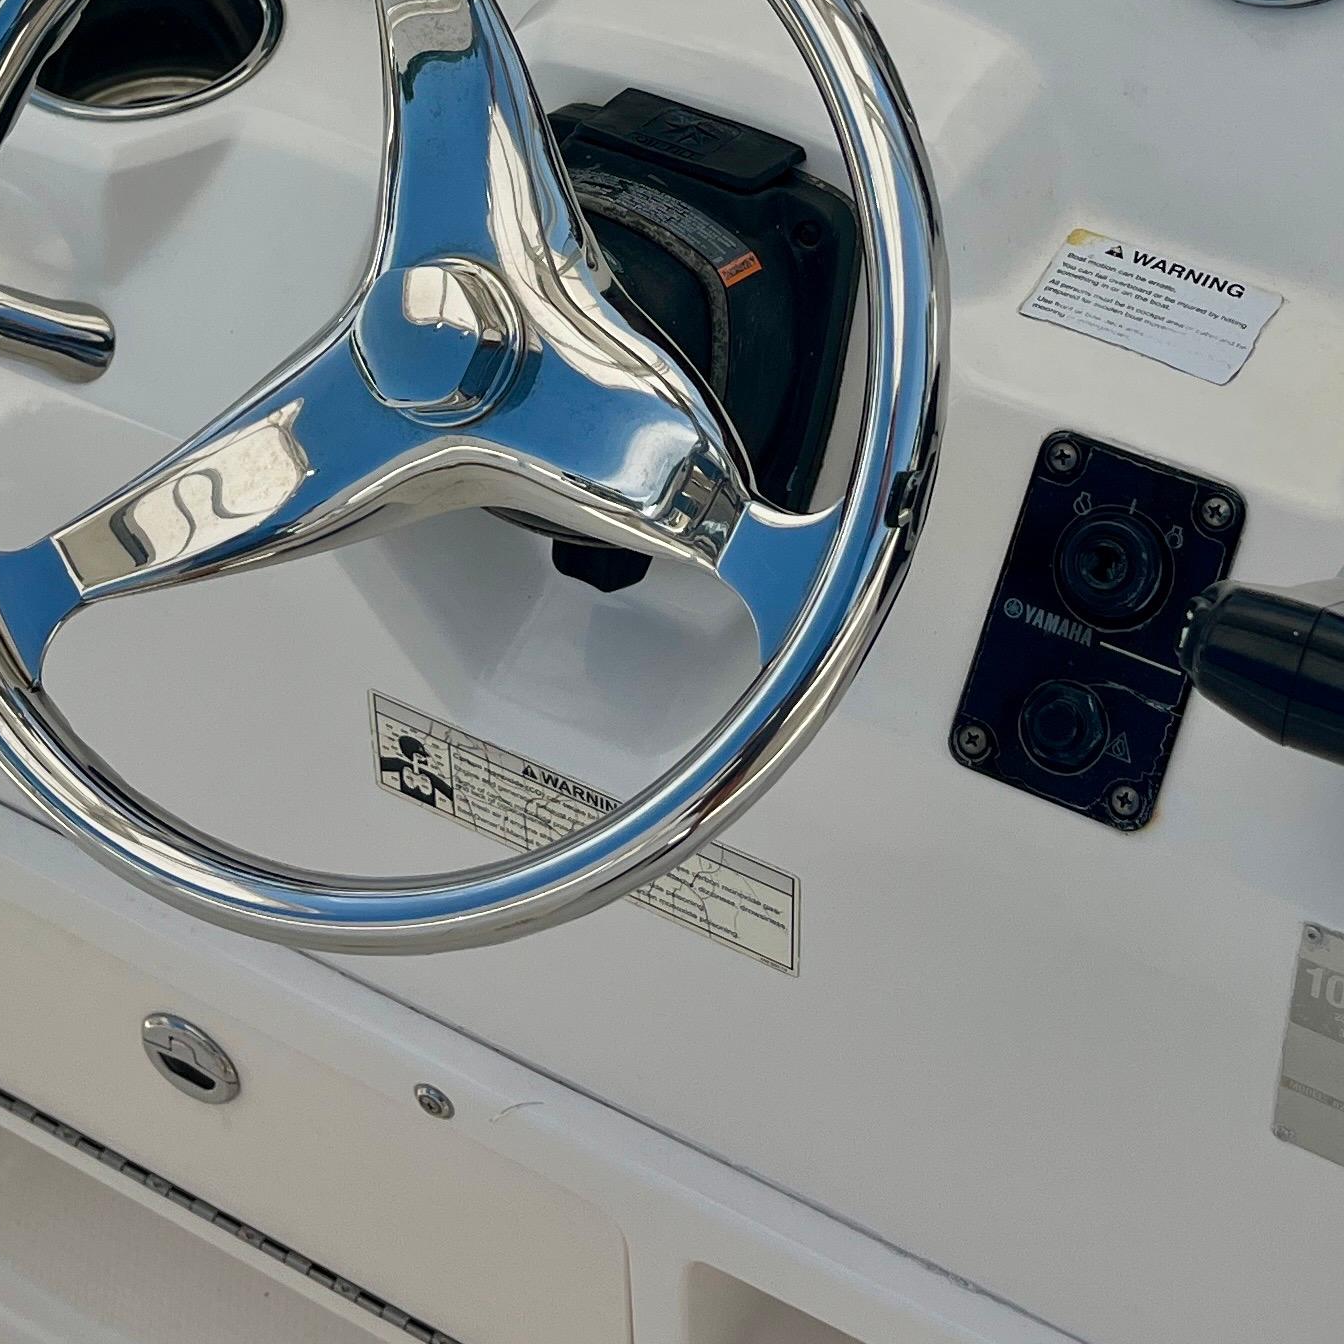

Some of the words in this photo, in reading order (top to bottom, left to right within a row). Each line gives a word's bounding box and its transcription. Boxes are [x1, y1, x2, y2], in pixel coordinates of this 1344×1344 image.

[1055, 267, 1100, 287] something
[1132, 293, 1149, 302] the
[1086, 258, 1118, 273] motion
[1116, 268, 1135, 278] can
[1133, 274, 1148, 282] be
[1133, 250, 1246, 299] WARNING
[1076, 266, 1094, 276] can
[1107, 276, 1153, 296] overboard
[1162, 295, 1176, 304] be
[1206, 310, 1220, 320] by
[1113, 299, 1126, 308] be
[1025, 603, 1092, 648] YAMAHA
[542, 771, 619, 812] WARNIN
[659, 897, 697, 919] monoxide
[721, 884, 761, 906] monoxide
